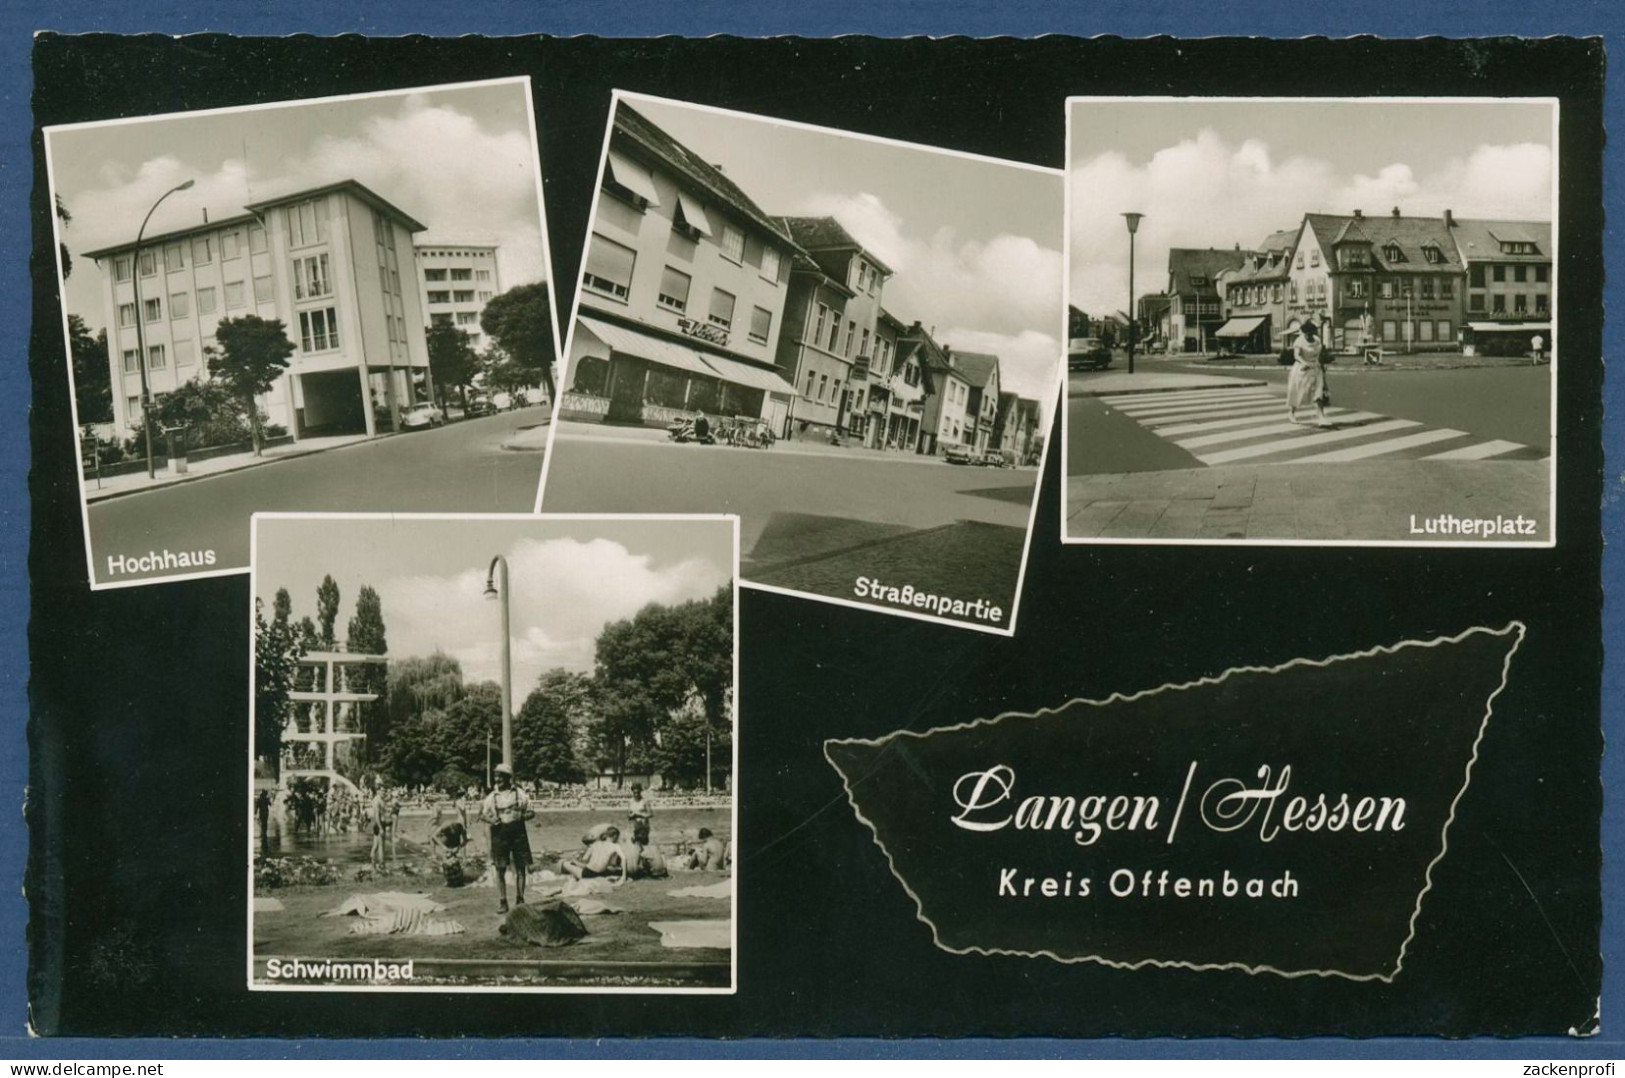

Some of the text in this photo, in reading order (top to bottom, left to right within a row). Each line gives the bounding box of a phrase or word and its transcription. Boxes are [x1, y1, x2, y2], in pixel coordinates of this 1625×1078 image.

[1410, 514, 1536, 538] Lutherplatz
[107, 548, 217, 575] Hochhaus
[854, 576, 1003, 622] Straßenpartie
[998, 867, 1299, 898] Kreis Offenbach
[266, 958, 414, 981] Schwimmbad
